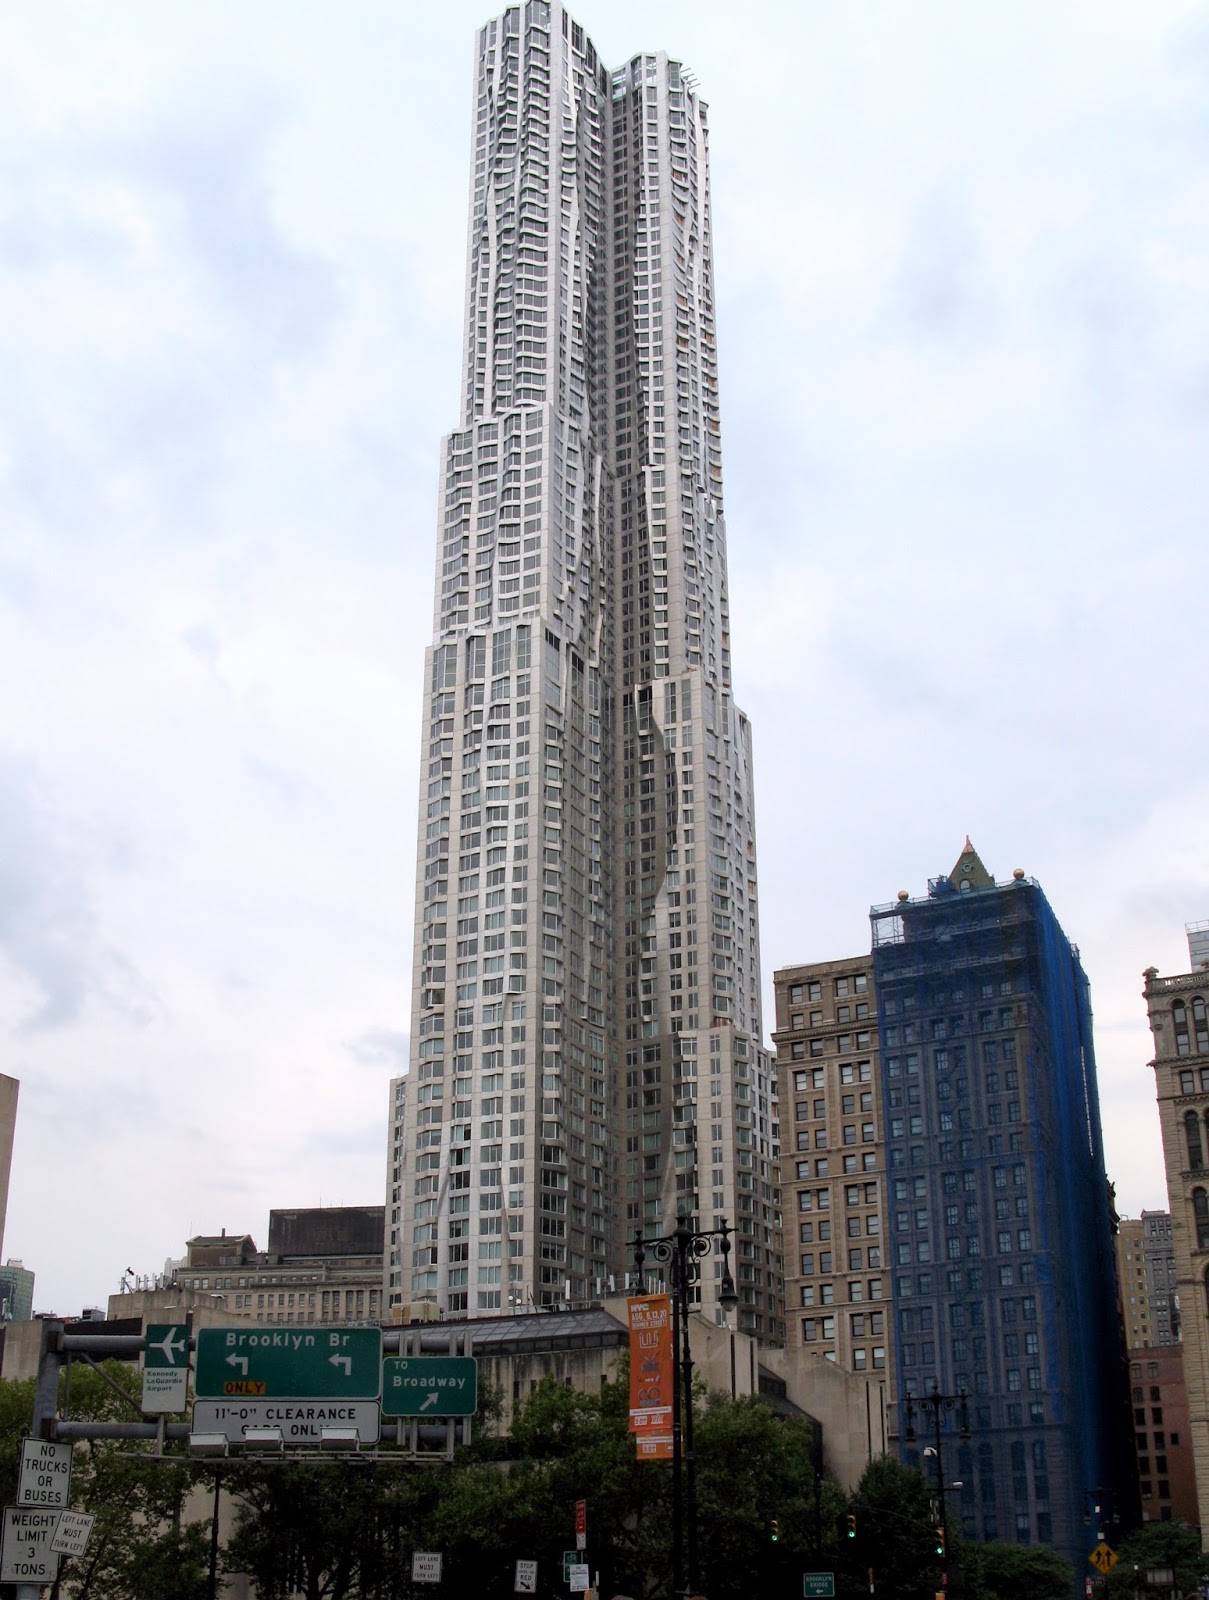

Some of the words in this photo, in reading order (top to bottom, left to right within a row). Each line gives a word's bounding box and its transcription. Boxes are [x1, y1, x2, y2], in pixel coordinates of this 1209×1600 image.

[631, 1303, 649, 1312] NYC
[226, 1332, 315, 1350] Brooklyn
[329, 1333, 350, 1346] Br
[394, 1361, 408, 1369] TO
[225, 1382, 264, 1393] ONLY
[393, 1376, 465, 1389] Broadway
[266, 1408, 356, 1420] CLEARANCE
[291, 1425, 330, 1436] ONL
[41, 1445, 56, 1457] NO
[26, 1459, 68, 1473] TRUCKS
[38, 1475, 53, 1487] OR
[25, 1489, 61, 1502] BUSES
[12, 1515, 56, 1527] WEIGHT
[62, 1515, 75, 1523] LEFT
[76, 1518, 91, 1527] LANE
[17, 1531, 48, 1541] LIMIT
[63, 1527, 82, 1538] MUST
[54, 1540, 68, 1548] TURN
[69, 1543, 83, 1551] LEFT
[28, 1547, 35, 1558] 3
[14, 1563, 46, 1575] TONS
